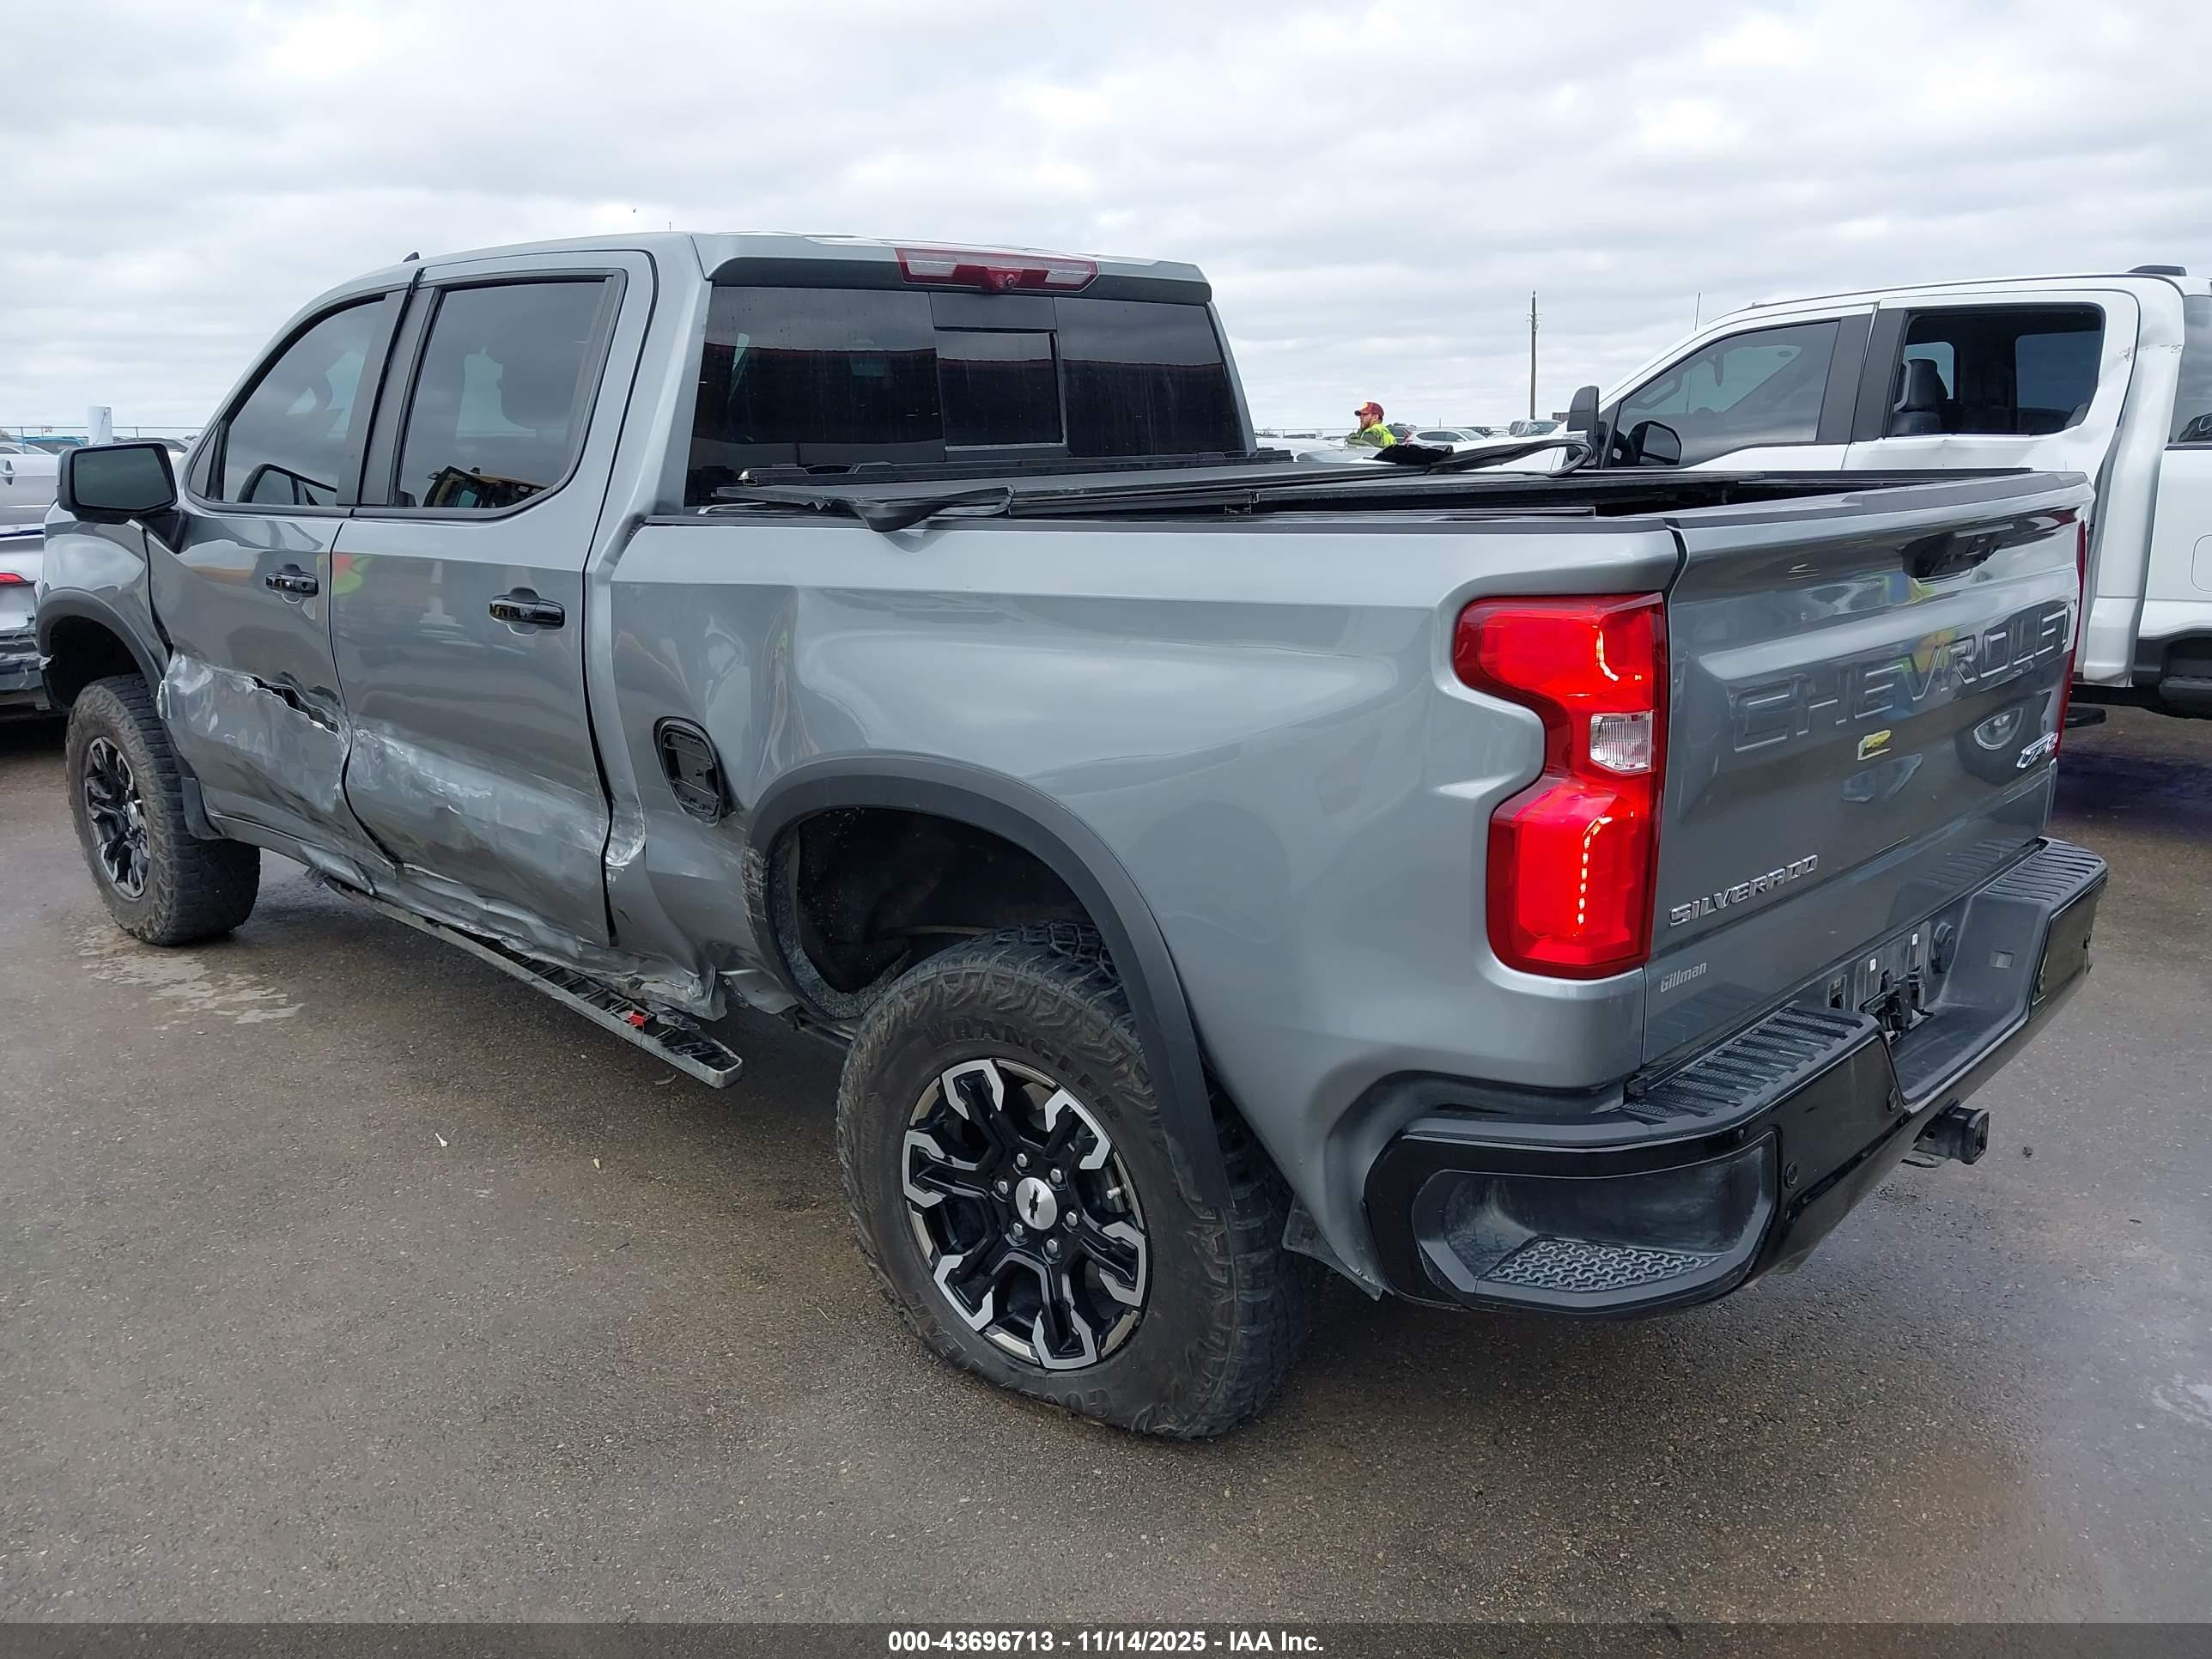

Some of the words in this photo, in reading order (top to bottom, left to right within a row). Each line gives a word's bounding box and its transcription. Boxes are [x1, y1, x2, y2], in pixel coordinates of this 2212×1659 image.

[1733, 601, 2075, 752] CHEVROLET
[1669, 854, 1819, 927] SILVERADO
[1660, 962, 1707, 994] Gillman
[921, 1018, 1122, 1121] WRANGLER
